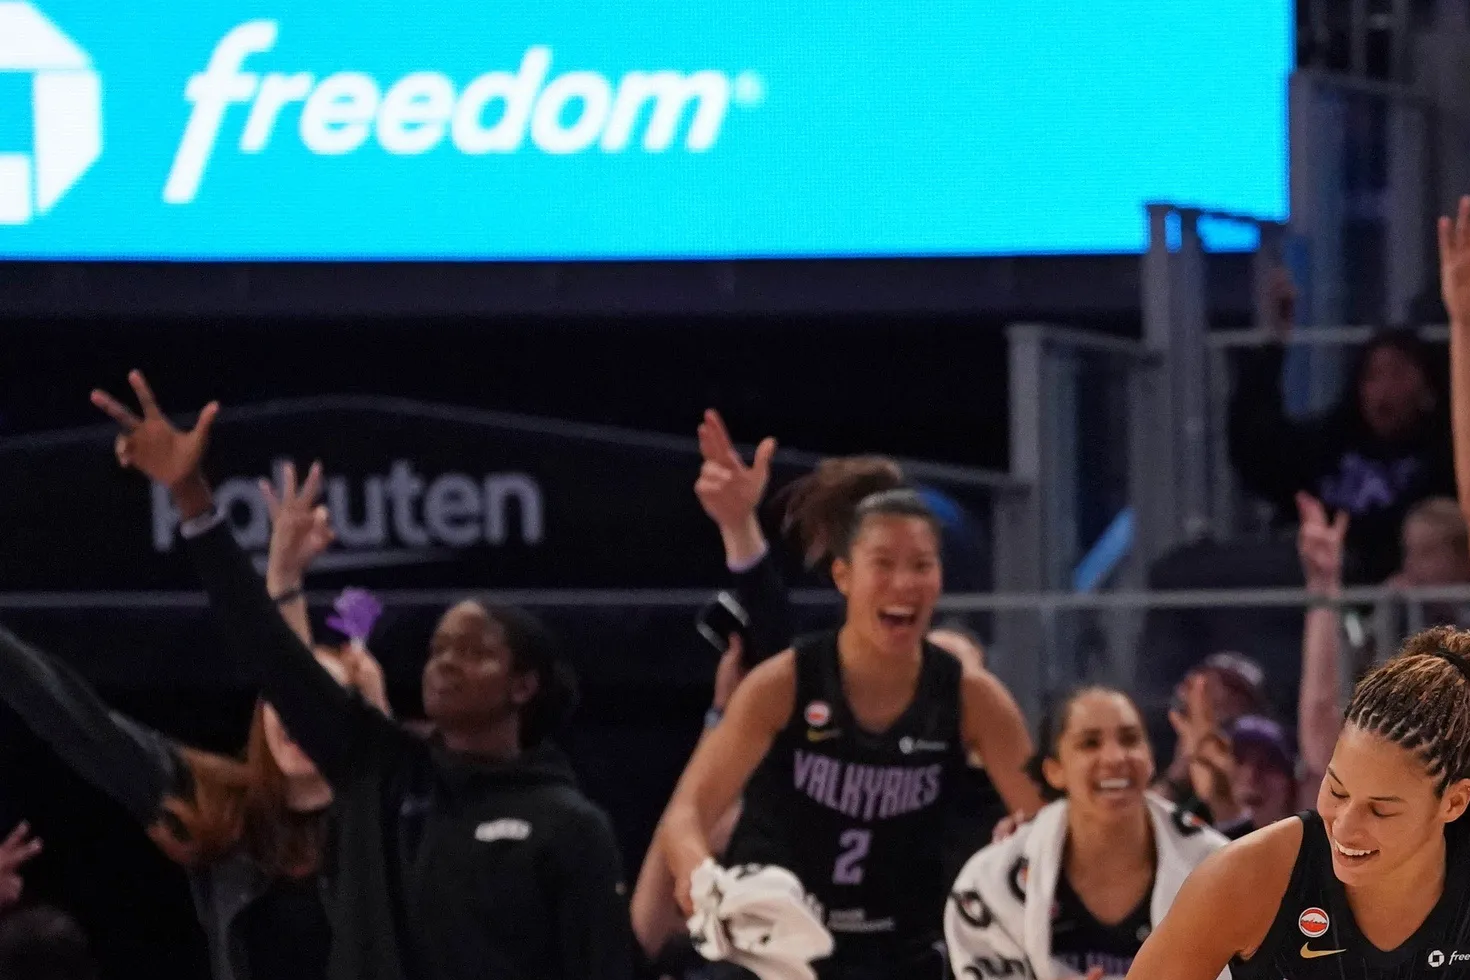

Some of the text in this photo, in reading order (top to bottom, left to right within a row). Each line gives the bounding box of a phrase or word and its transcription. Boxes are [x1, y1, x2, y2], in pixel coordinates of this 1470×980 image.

[162, 19, 727, 204] freedom
[152, 456, 545, 553] auten
[793, 748, 942, 821] VALKYRIES
[832, 829, 872, 885] 2
